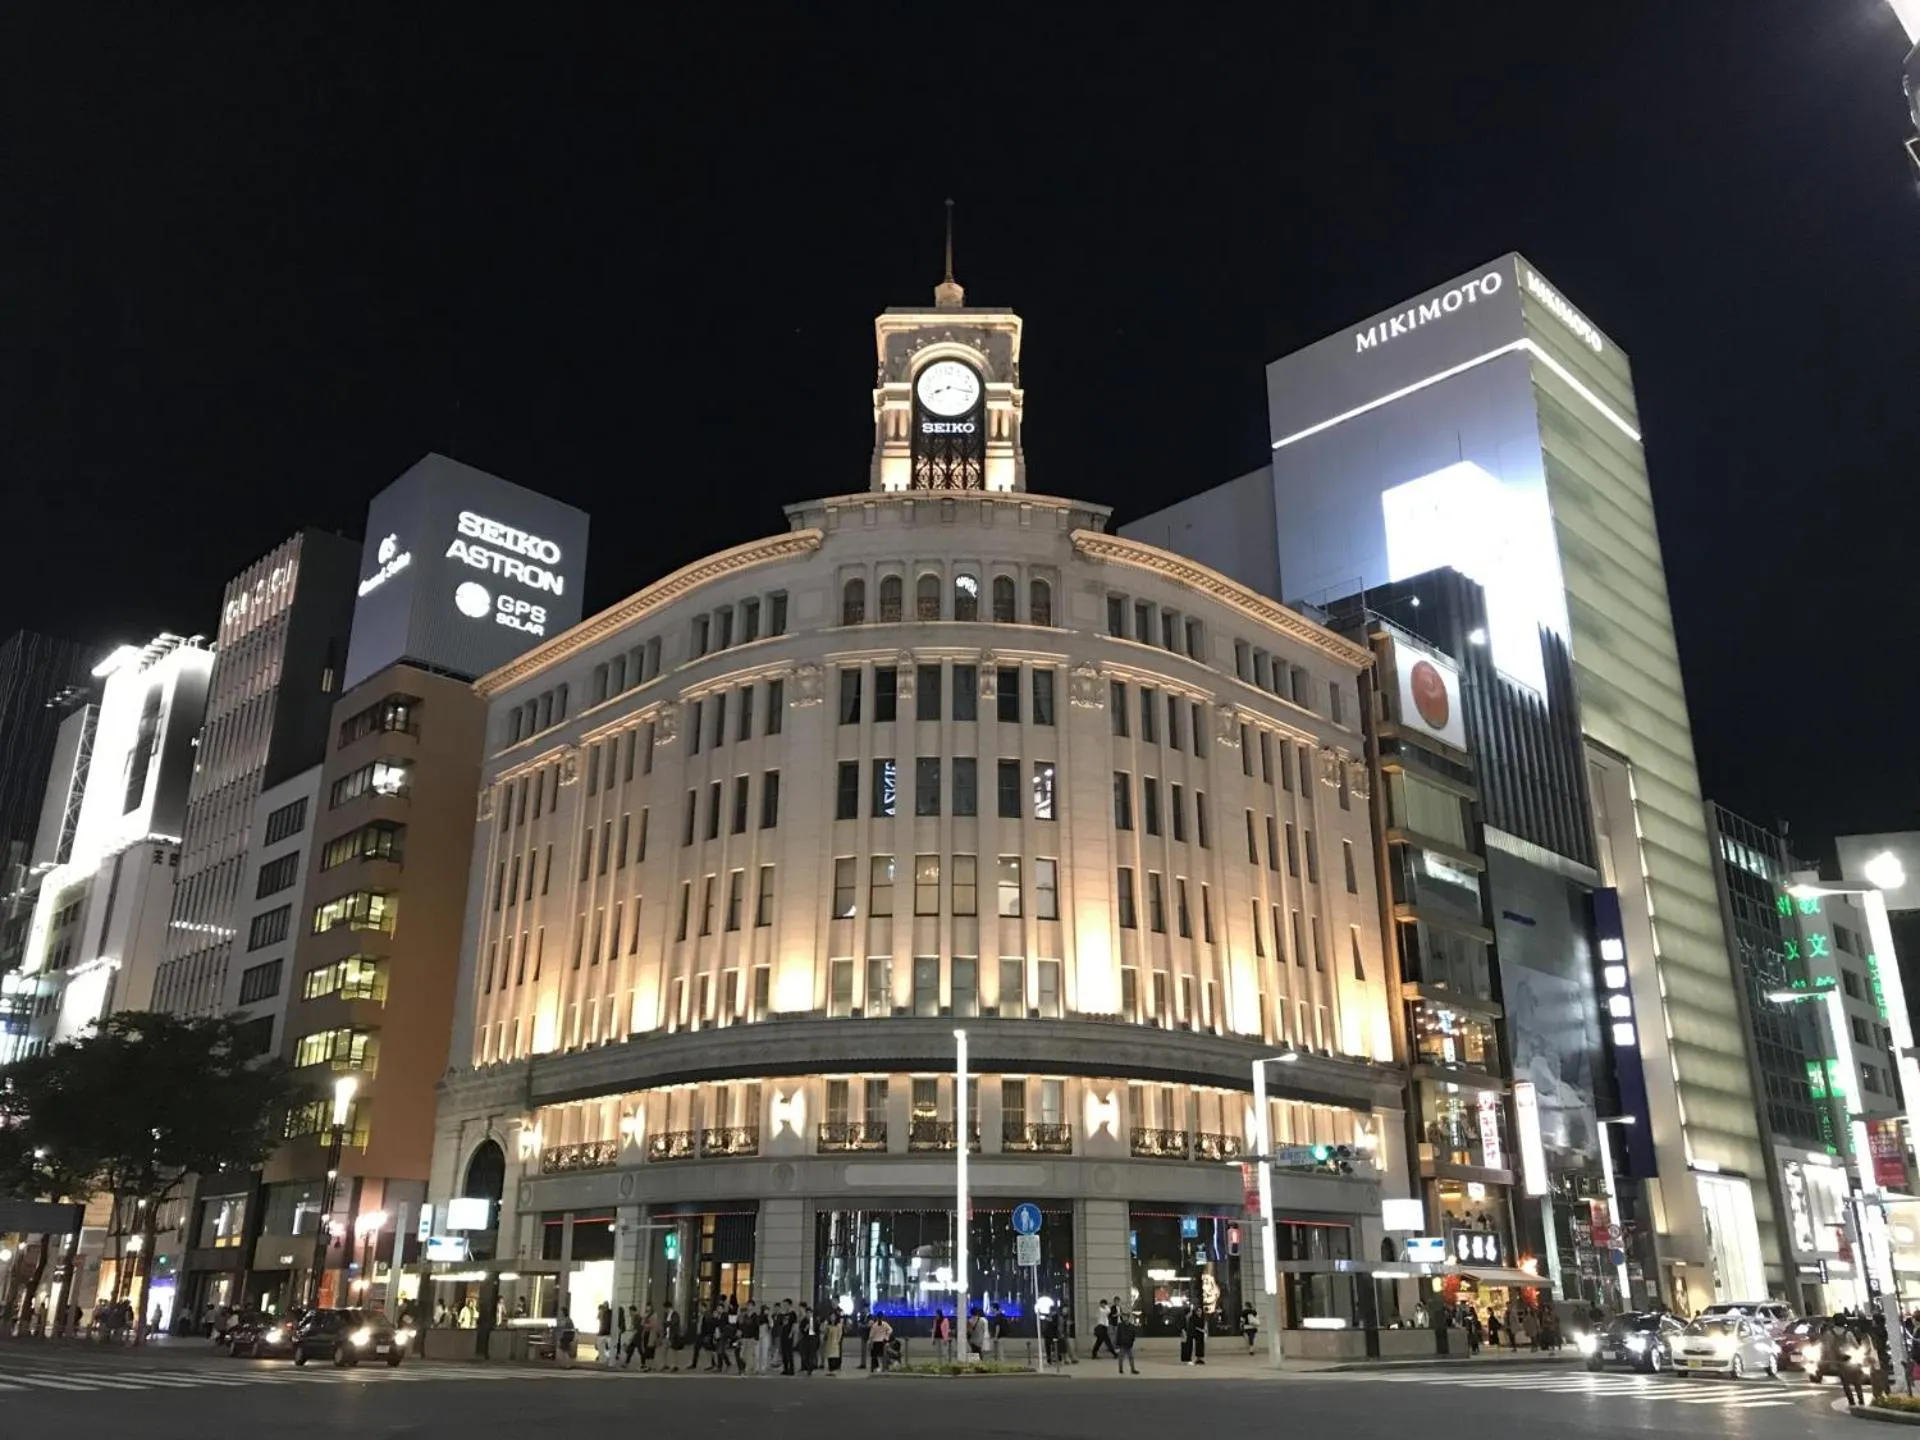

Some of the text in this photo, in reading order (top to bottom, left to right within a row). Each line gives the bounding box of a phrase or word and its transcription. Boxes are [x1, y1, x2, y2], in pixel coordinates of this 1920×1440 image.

[1356, 271, 1502, 353] MIKIMOTO
[1527, 270, 1602, 352] MIKIMOTO
[922, 423, 975, 433] SEIKO
[458, 511, 561, 564] SEIKO
[445, 538, 564, 596] ASTRON
[495, 612, 545, 637] SOLAR
[497, 594, 547, 624] GPS
